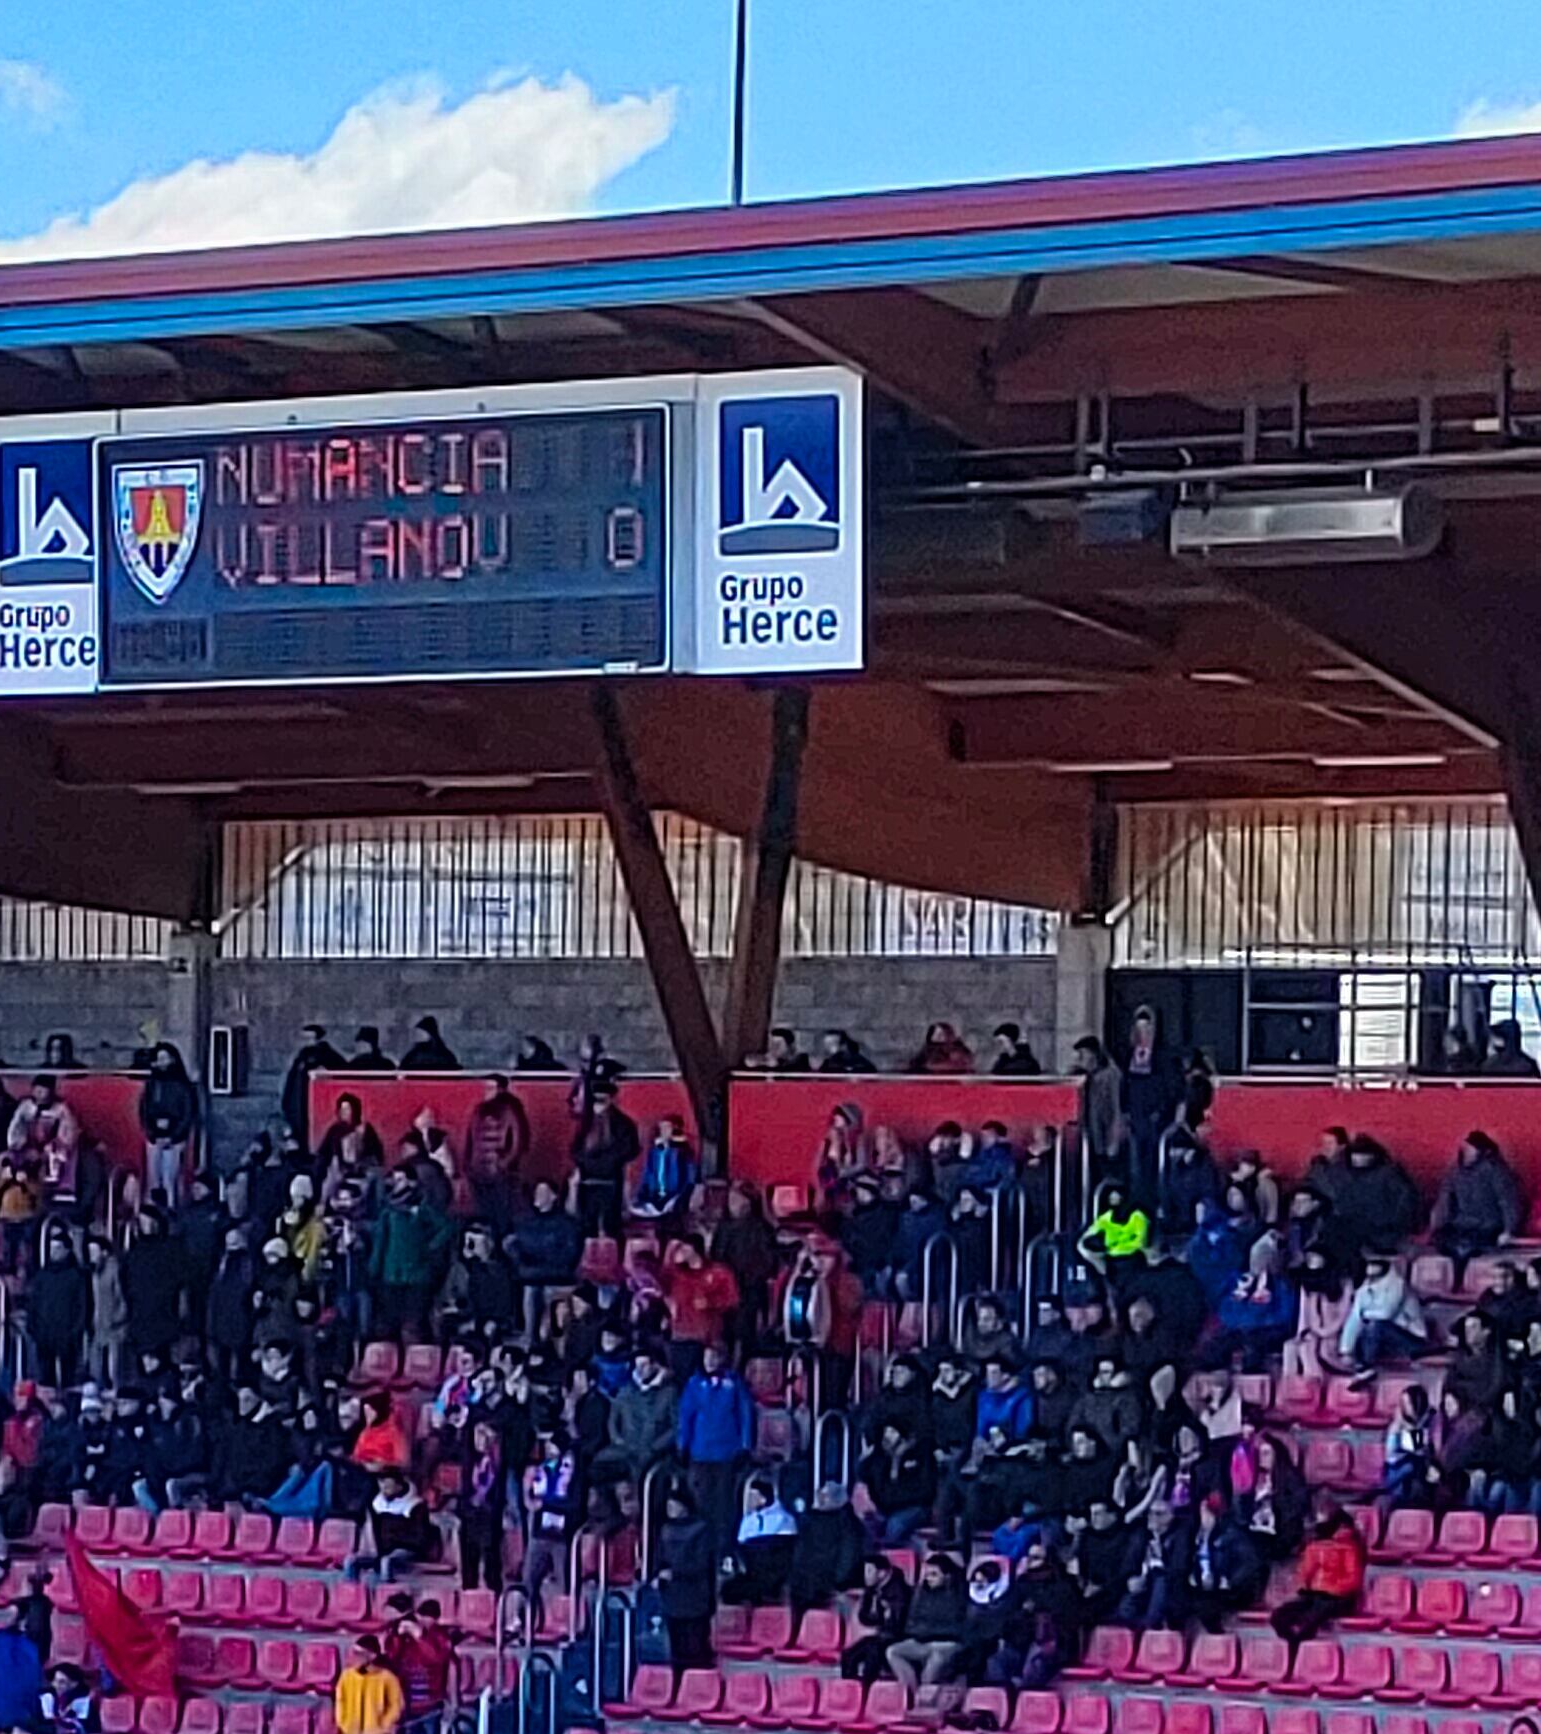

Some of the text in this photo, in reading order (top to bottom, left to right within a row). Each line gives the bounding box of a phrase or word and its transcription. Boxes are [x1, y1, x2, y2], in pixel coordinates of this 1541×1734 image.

[216, 428, 509, 506] NUMANCIA
[214, 505, 646, 588] VILLANOV 0
[719, 573, 804, 609] Grupo
[720, 603, 839, 645] Herce
